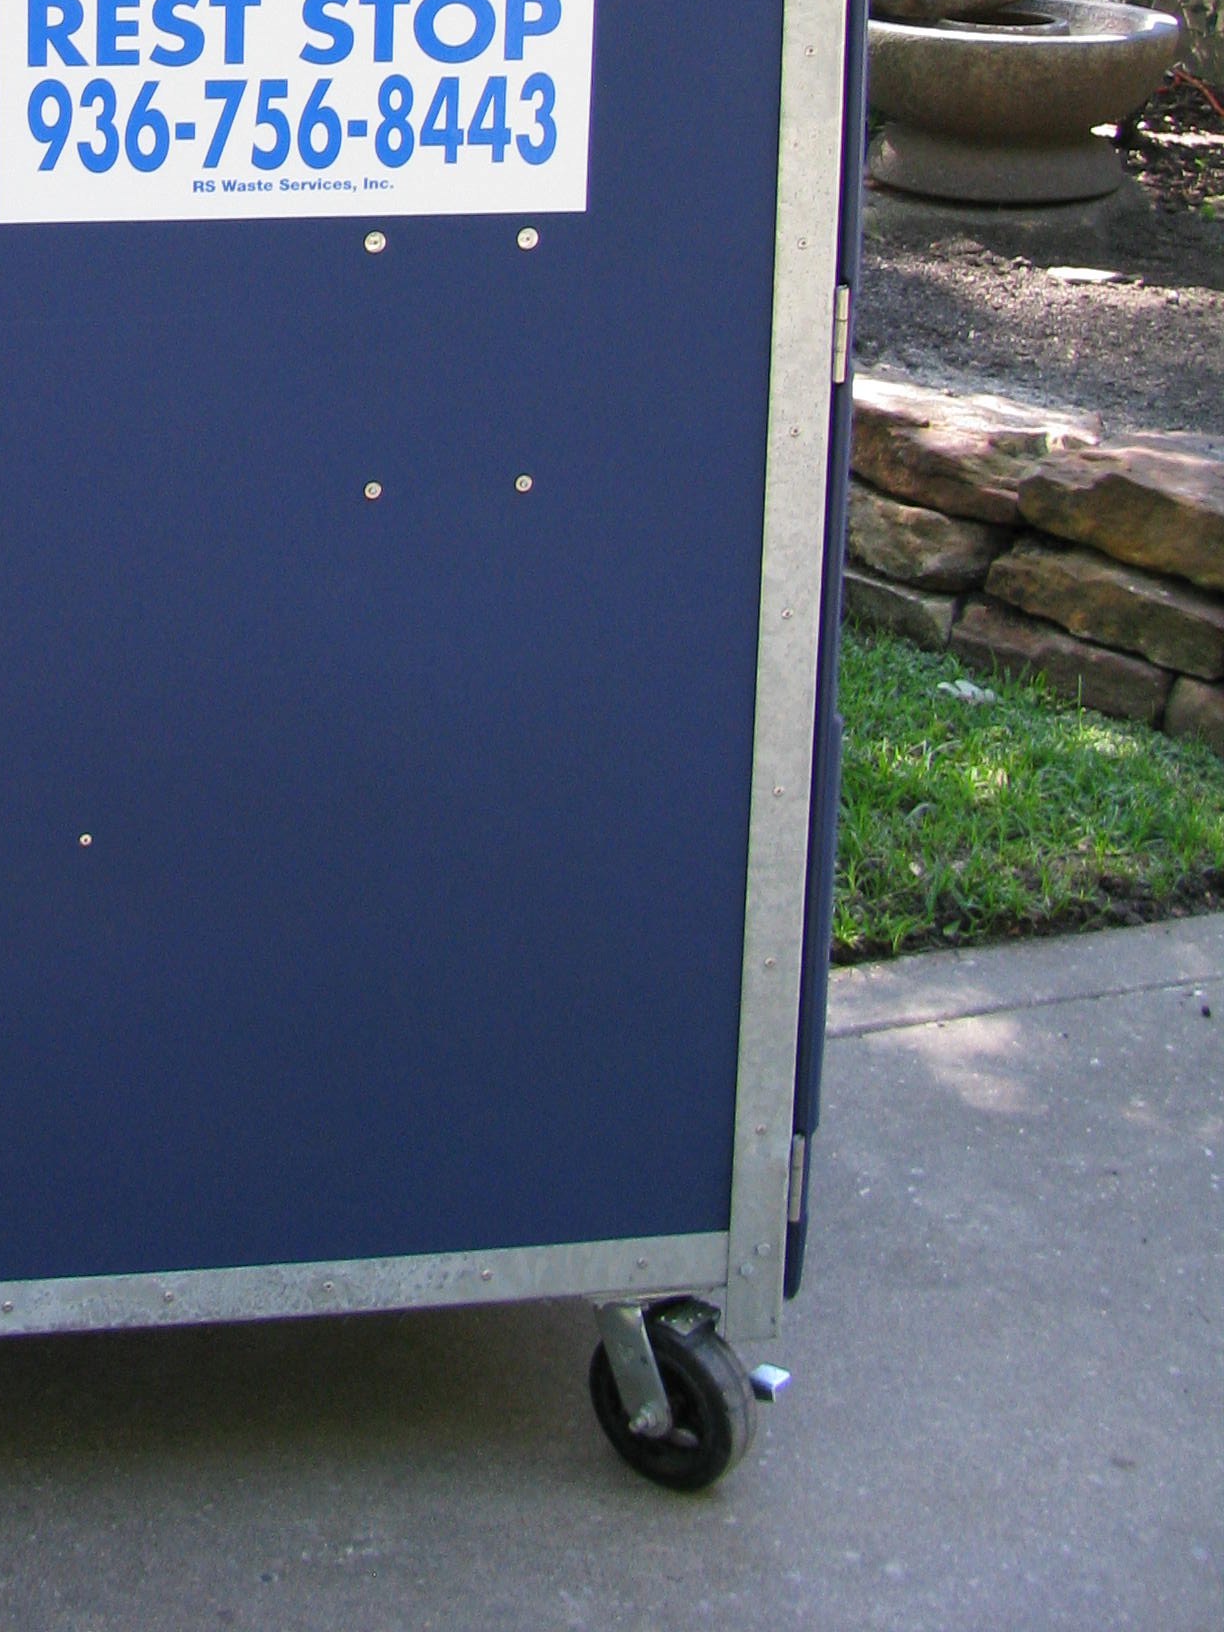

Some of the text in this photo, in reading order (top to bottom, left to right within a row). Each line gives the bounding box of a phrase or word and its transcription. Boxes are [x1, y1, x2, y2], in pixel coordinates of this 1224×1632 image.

[27, 71, 558, 174] 936-756-8443
[192, 177, 395, 193] RS Waste Services, Inc.
